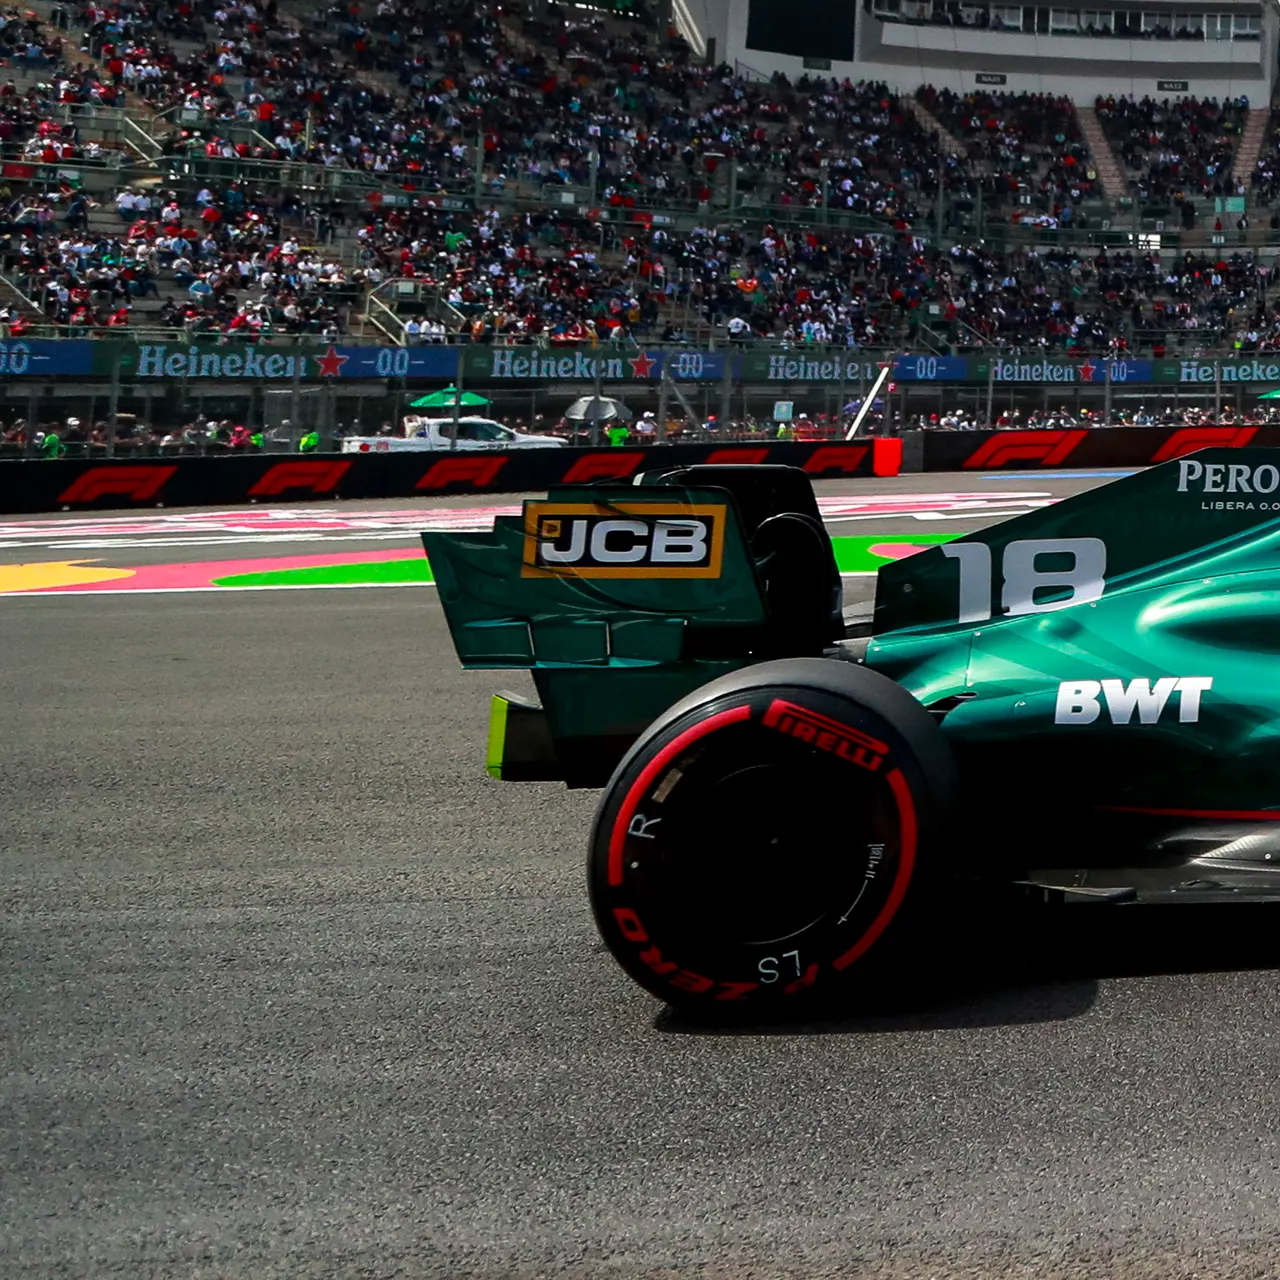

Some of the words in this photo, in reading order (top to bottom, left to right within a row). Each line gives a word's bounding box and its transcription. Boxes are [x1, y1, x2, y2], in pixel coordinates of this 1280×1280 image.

[136, 345, 307, 377] Heineken
[490, 350, 624, 379] Heineken
[1201, 500, 1255, 511] LIBERA
[540, 519, 708, 564] JCB
[940, 537, 1107, 624] 18
[1054, 676, 1213, 725] BWT
[760, 698, 893, 773] PIRELLI
